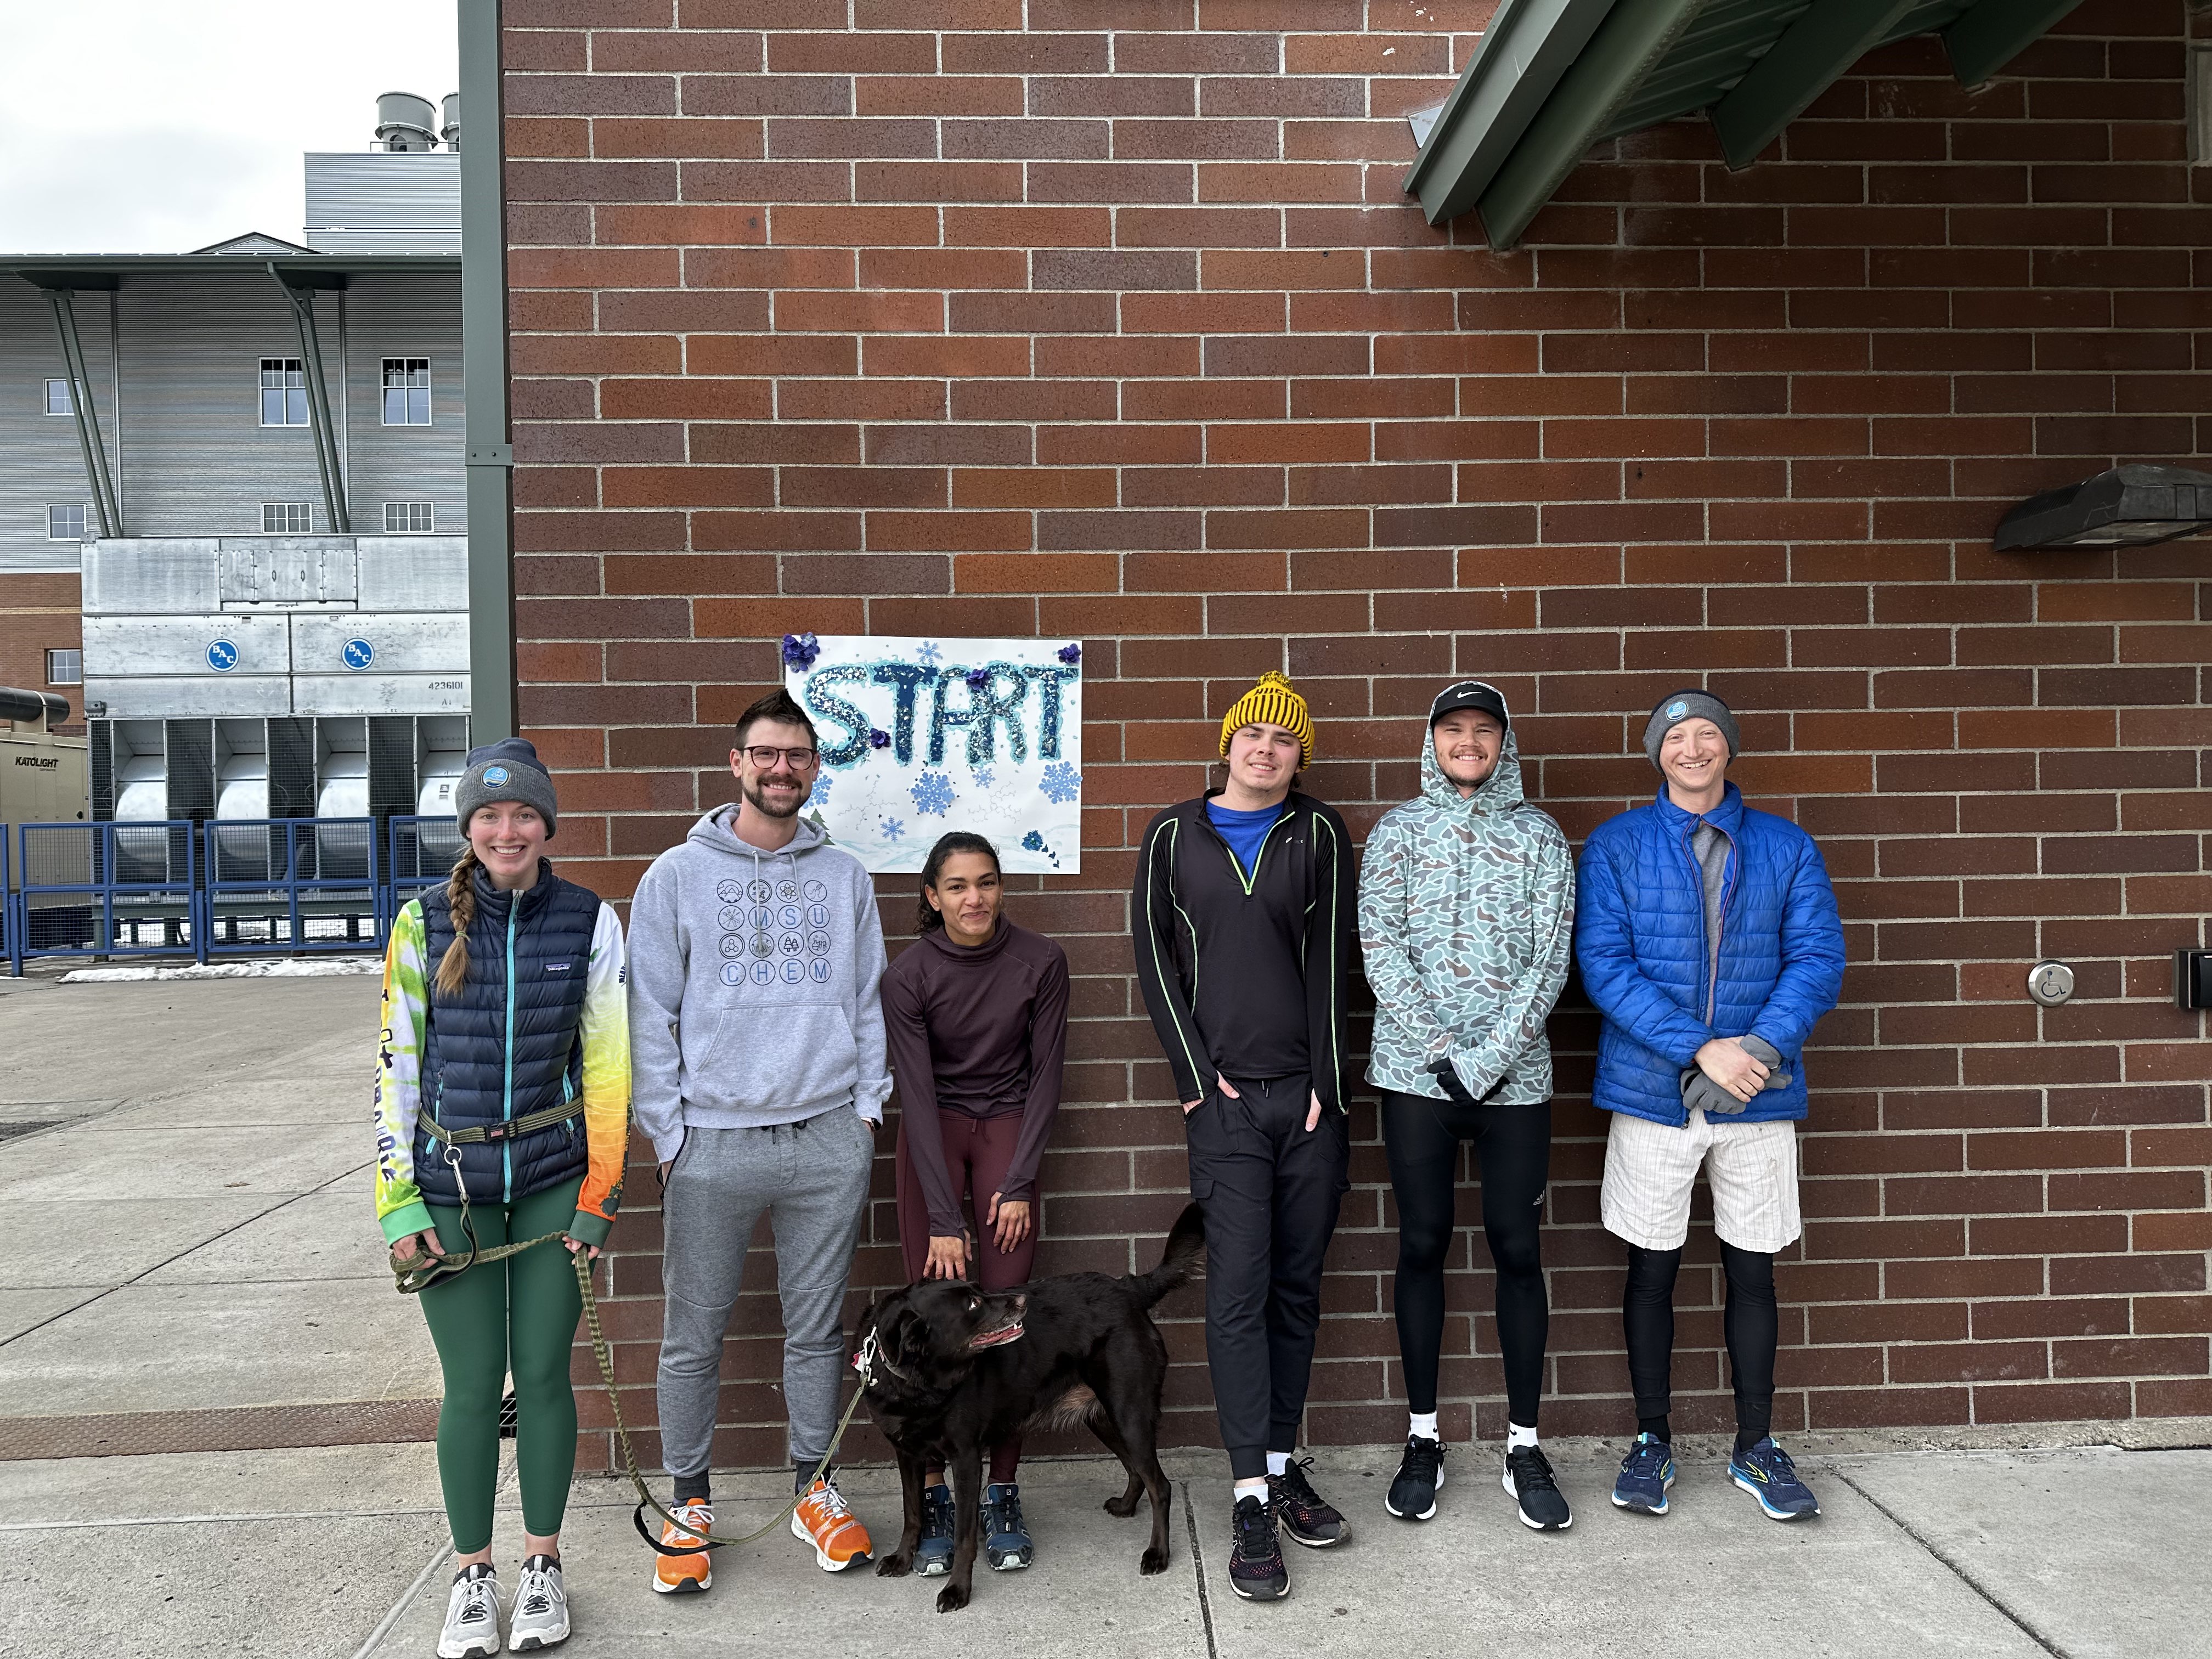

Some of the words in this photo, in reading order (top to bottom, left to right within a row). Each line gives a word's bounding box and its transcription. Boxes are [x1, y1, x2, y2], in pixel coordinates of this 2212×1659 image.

[212, 645, 234, 664] BAC
[348, 644, 369, 663] BAC
[428, 681, 463, 690] 4236101
[804, 659, 1080, 772] START
[15, 757, 59, 768] KATOLIGHT
